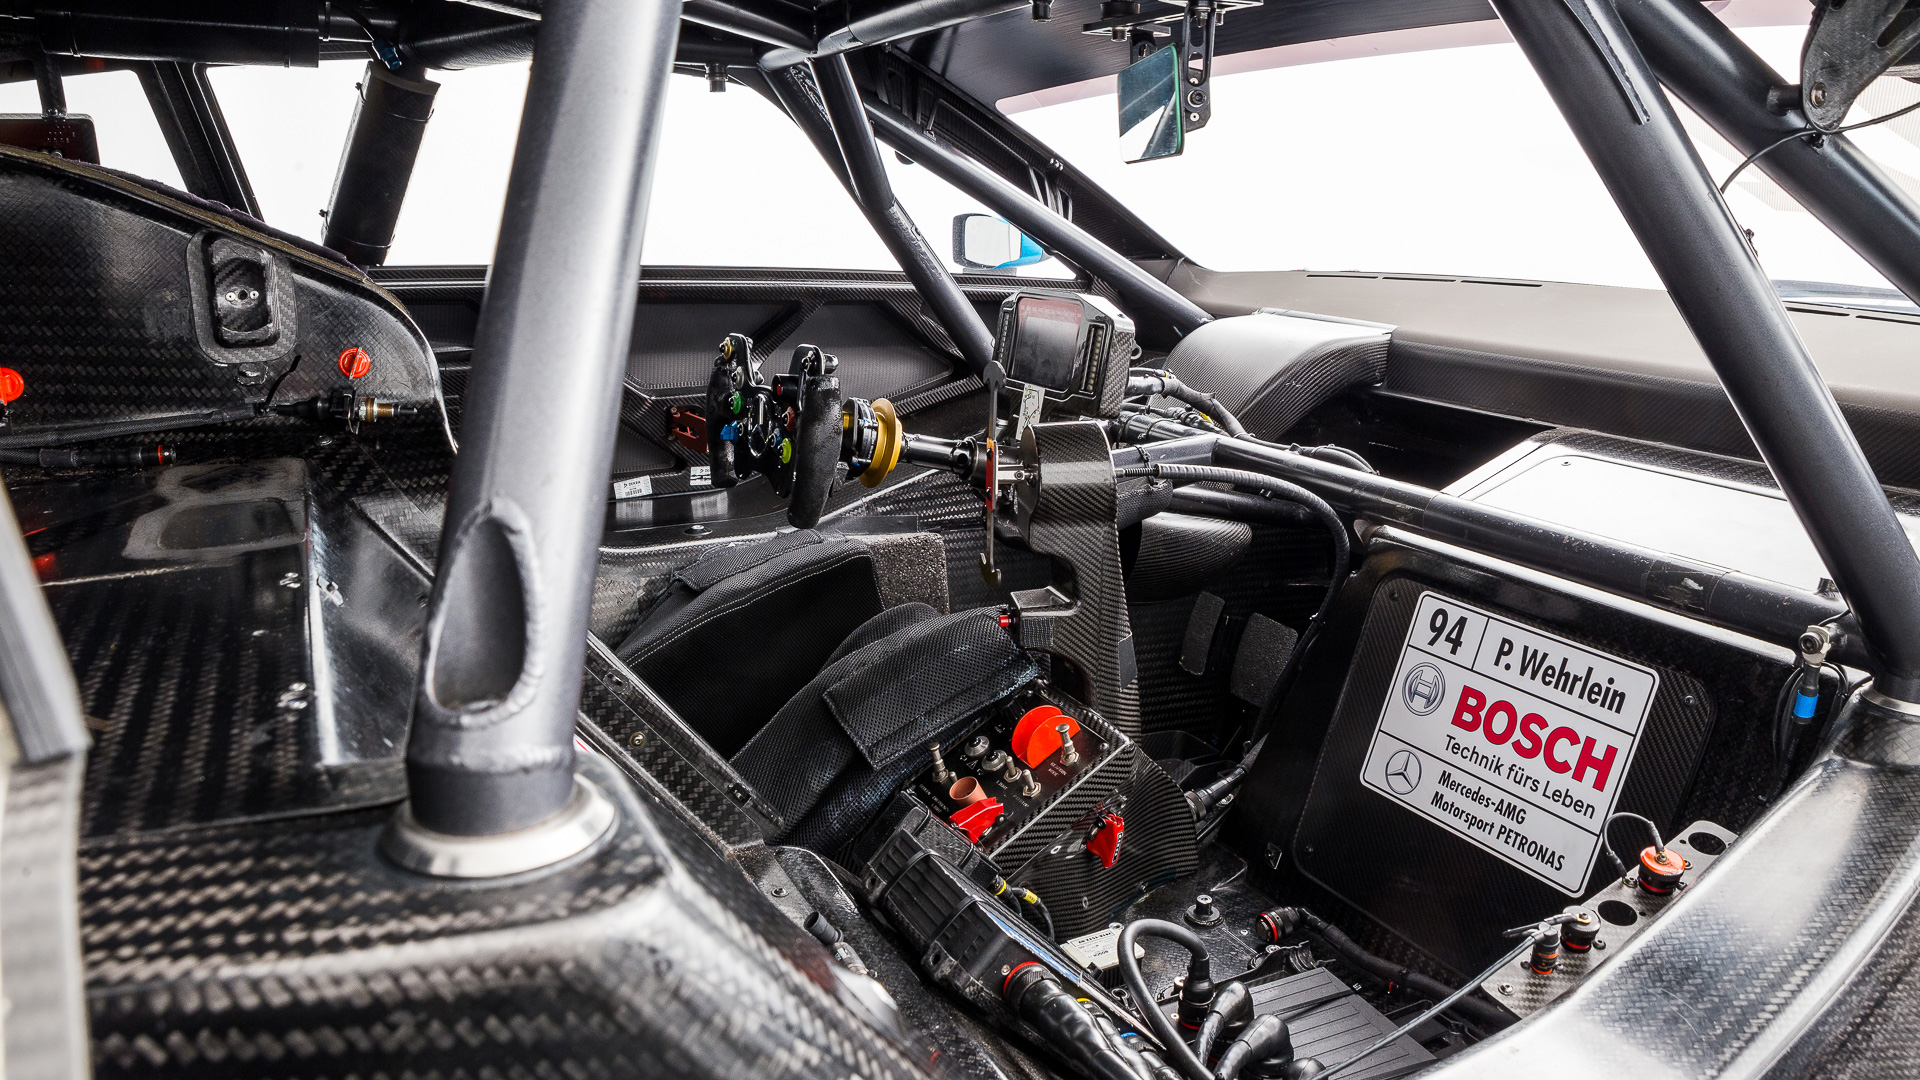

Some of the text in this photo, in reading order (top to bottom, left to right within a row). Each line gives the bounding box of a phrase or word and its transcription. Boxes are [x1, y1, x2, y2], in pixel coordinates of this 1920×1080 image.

[1427, 608, 1469, 655] 94
[1493, 637, 1627, 714] P. Wehrlein
[1446, 734, 1596, 819] Technik fürs Leben
[1450, 684, 1619, 792] BOSCH
[1430, 791, 1566, 872] Motorsport PETRONAS
[1438, 770, 1527, 825] Mercedes-AMG
